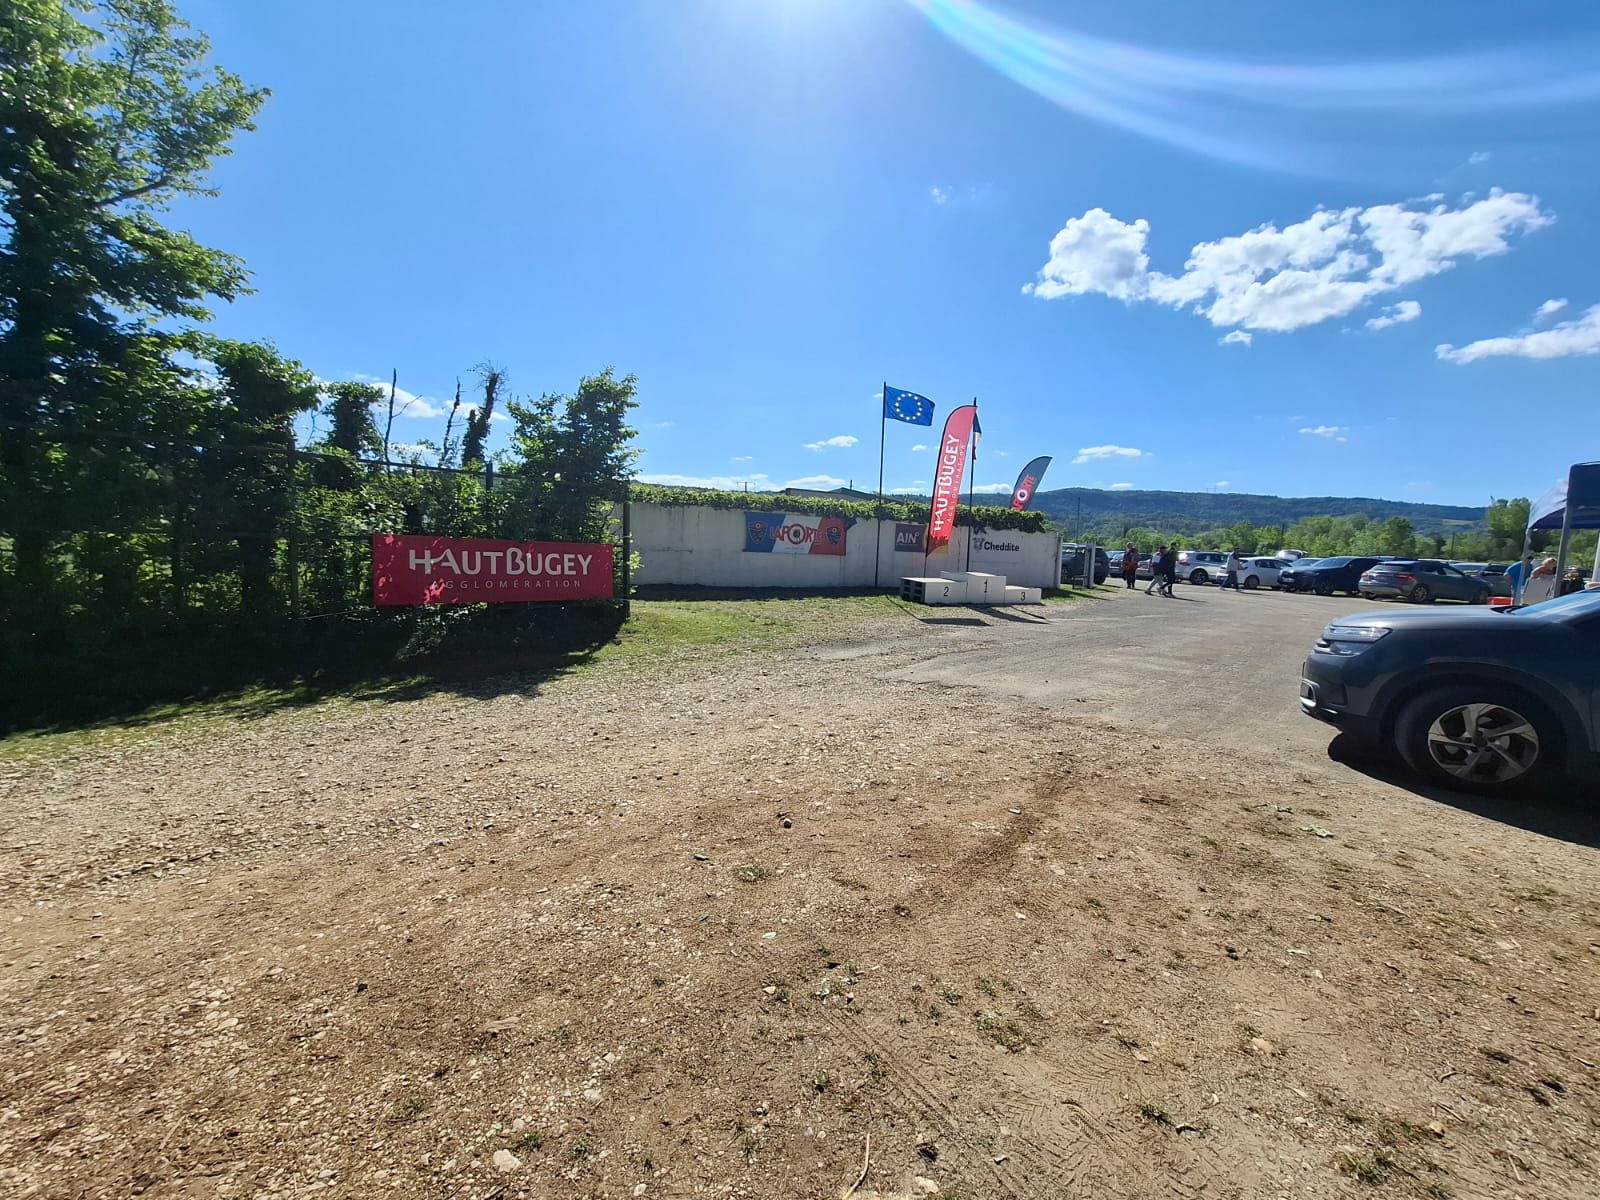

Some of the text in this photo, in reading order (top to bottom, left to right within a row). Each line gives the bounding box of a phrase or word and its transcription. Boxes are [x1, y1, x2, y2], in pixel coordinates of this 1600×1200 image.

[983, 541, 1020, 552] Cheddite
[430, 579, 582, 590] AGGLOMÉRATION
[983, 578, 988, 593] 1
[943, 586, 950, 597] 2
[1020, 591, 1026, 601] 3
